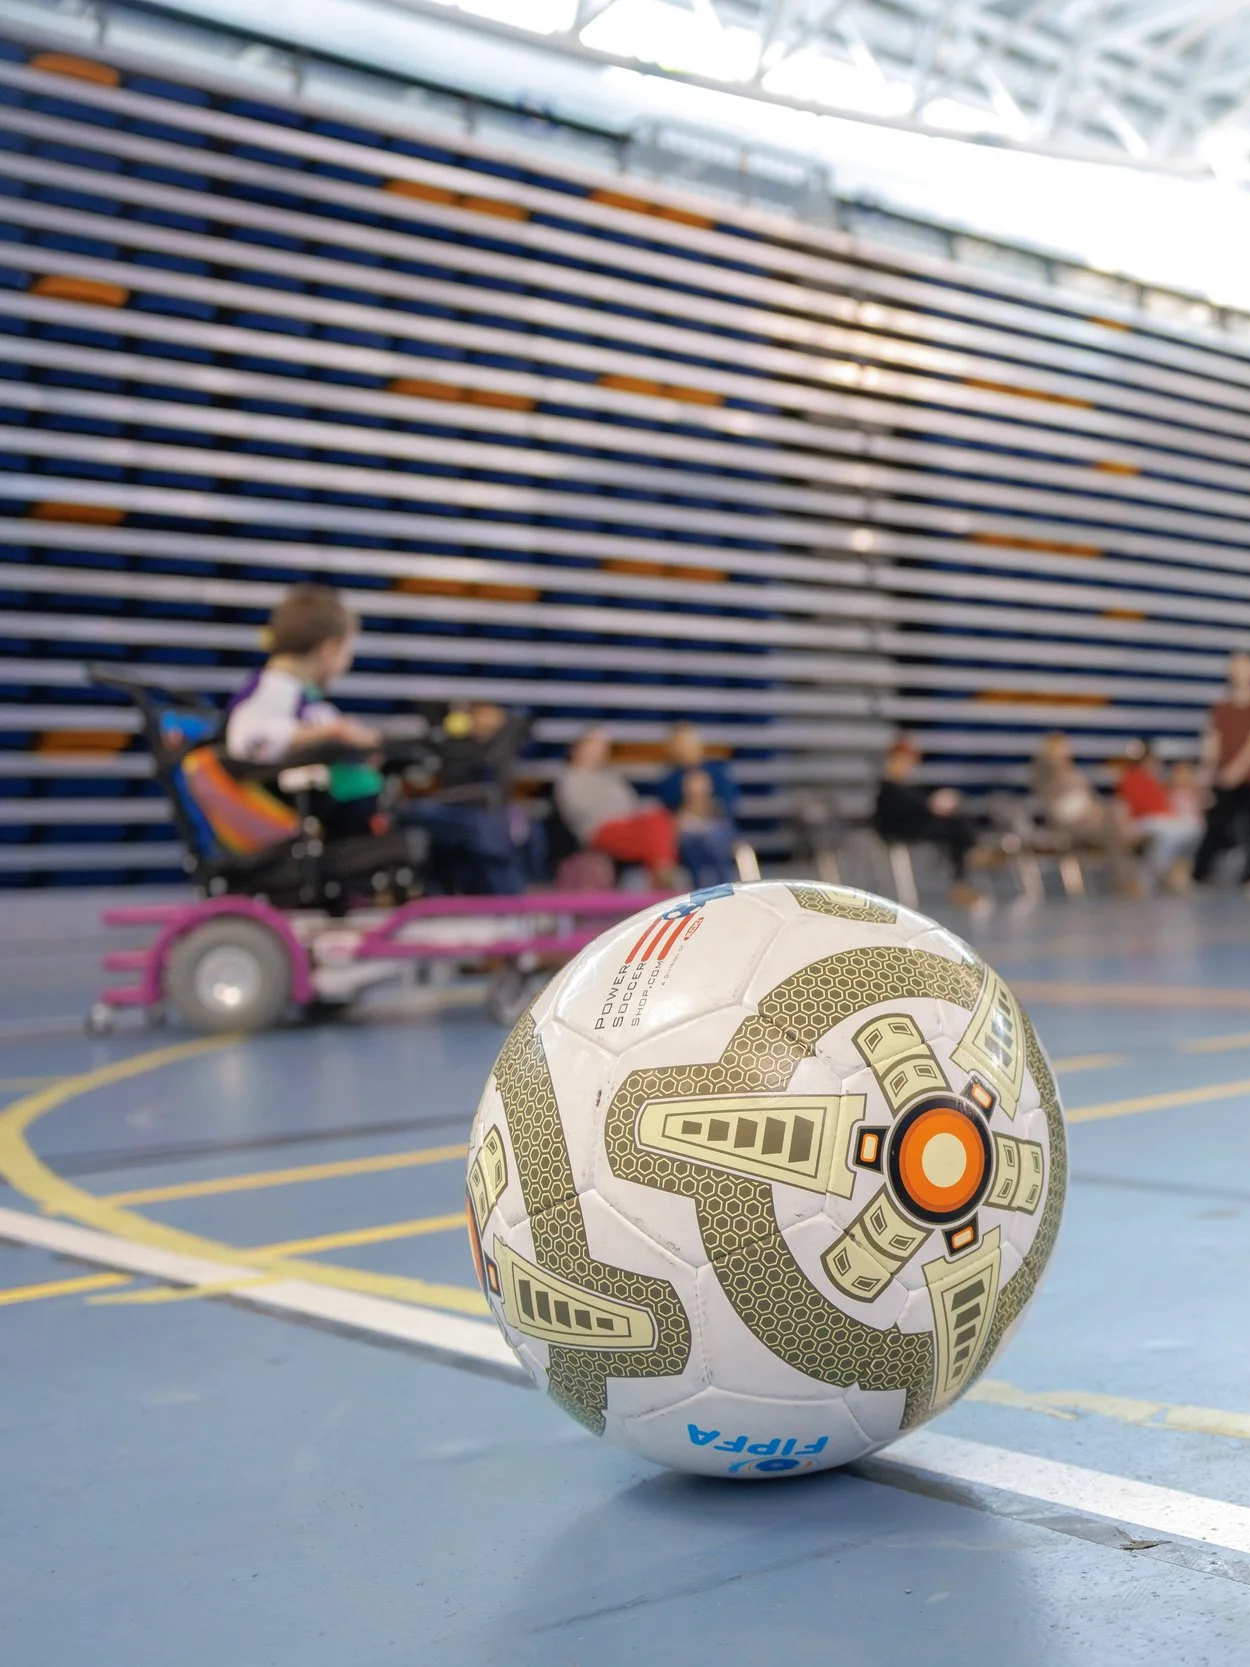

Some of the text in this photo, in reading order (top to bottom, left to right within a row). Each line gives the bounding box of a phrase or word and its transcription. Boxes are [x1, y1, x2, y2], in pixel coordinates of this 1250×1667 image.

[594, 964, 630, 1030] POWER
[612, 962, 646, 1028] SOCCER
[687, 1423, 829, 1456] FIPFA
